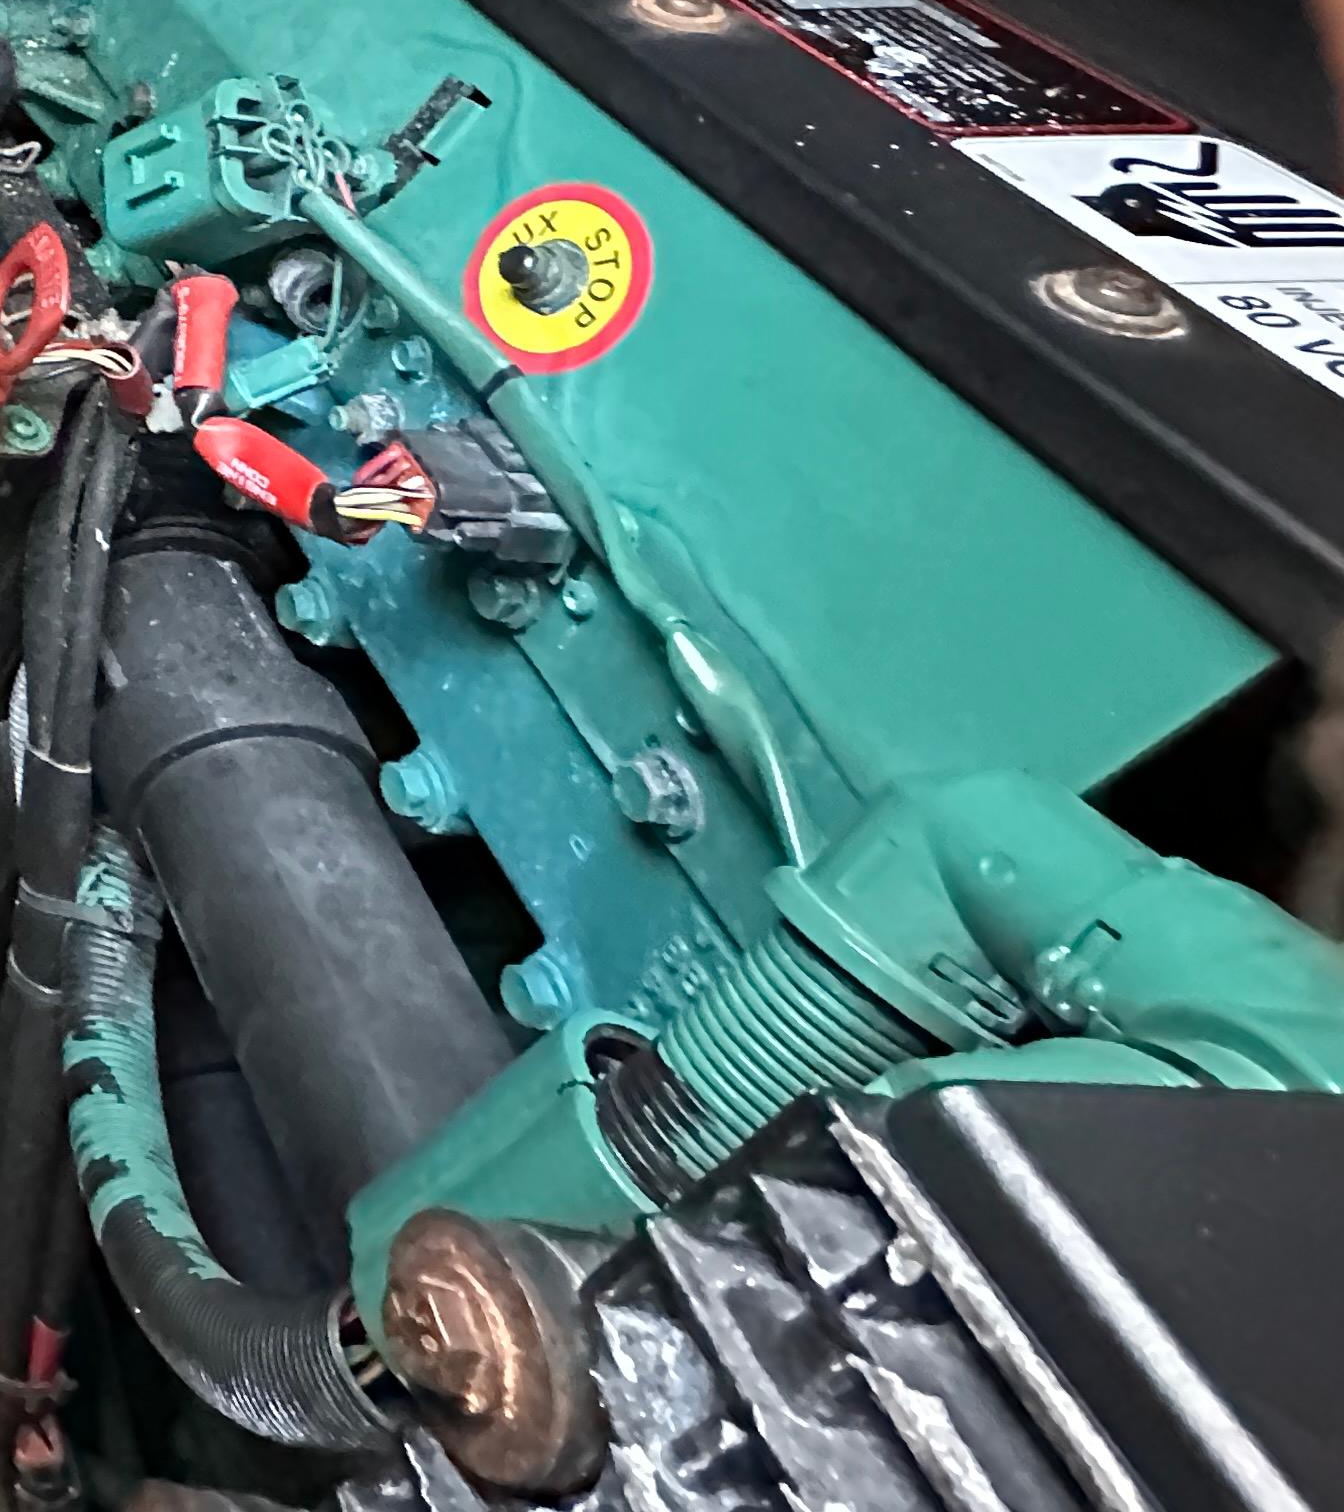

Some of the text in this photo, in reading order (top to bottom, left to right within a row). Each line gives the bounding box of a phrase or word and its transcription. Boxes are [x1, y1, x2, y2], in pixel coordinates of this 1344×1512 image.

[512, 210, 621, 328] UX STOP
[1217, 295, 1301, 328] 80
[1275, 287, 1344, 330] INJE
